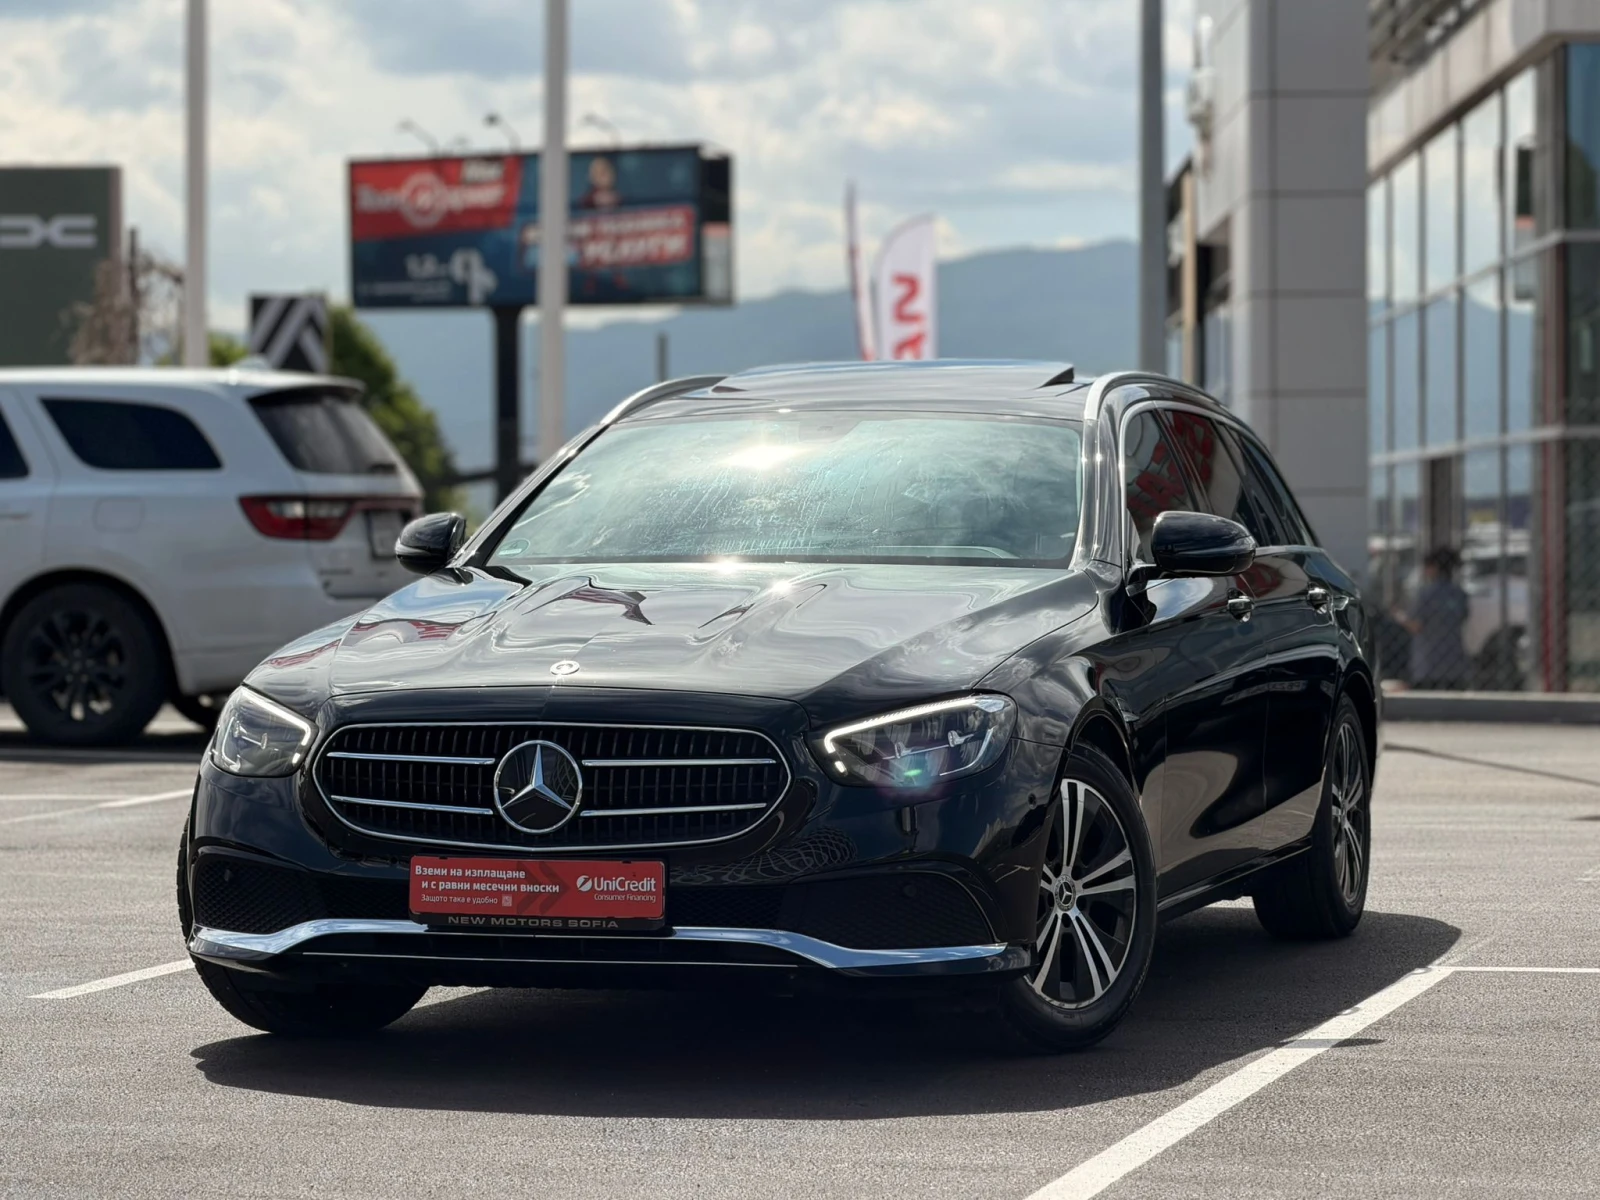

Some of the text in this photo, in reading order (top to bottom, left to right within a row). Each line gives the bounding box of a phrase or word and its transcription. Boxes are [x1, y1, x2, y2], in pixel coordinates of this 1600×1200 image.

[415, 865, 526, 880] Вземи на изплащане
[421, 880, 560, 893] и с равни месечни вноски
[594, 876, 656, 892] UniCredit
[421, 893, 448, 902] Защото
[473, 895, 498, 905] удобно
[594, 893, 656, 904] Consumer Financing
[448, 916, 619, 928] NEW MOTORS SOFIA
